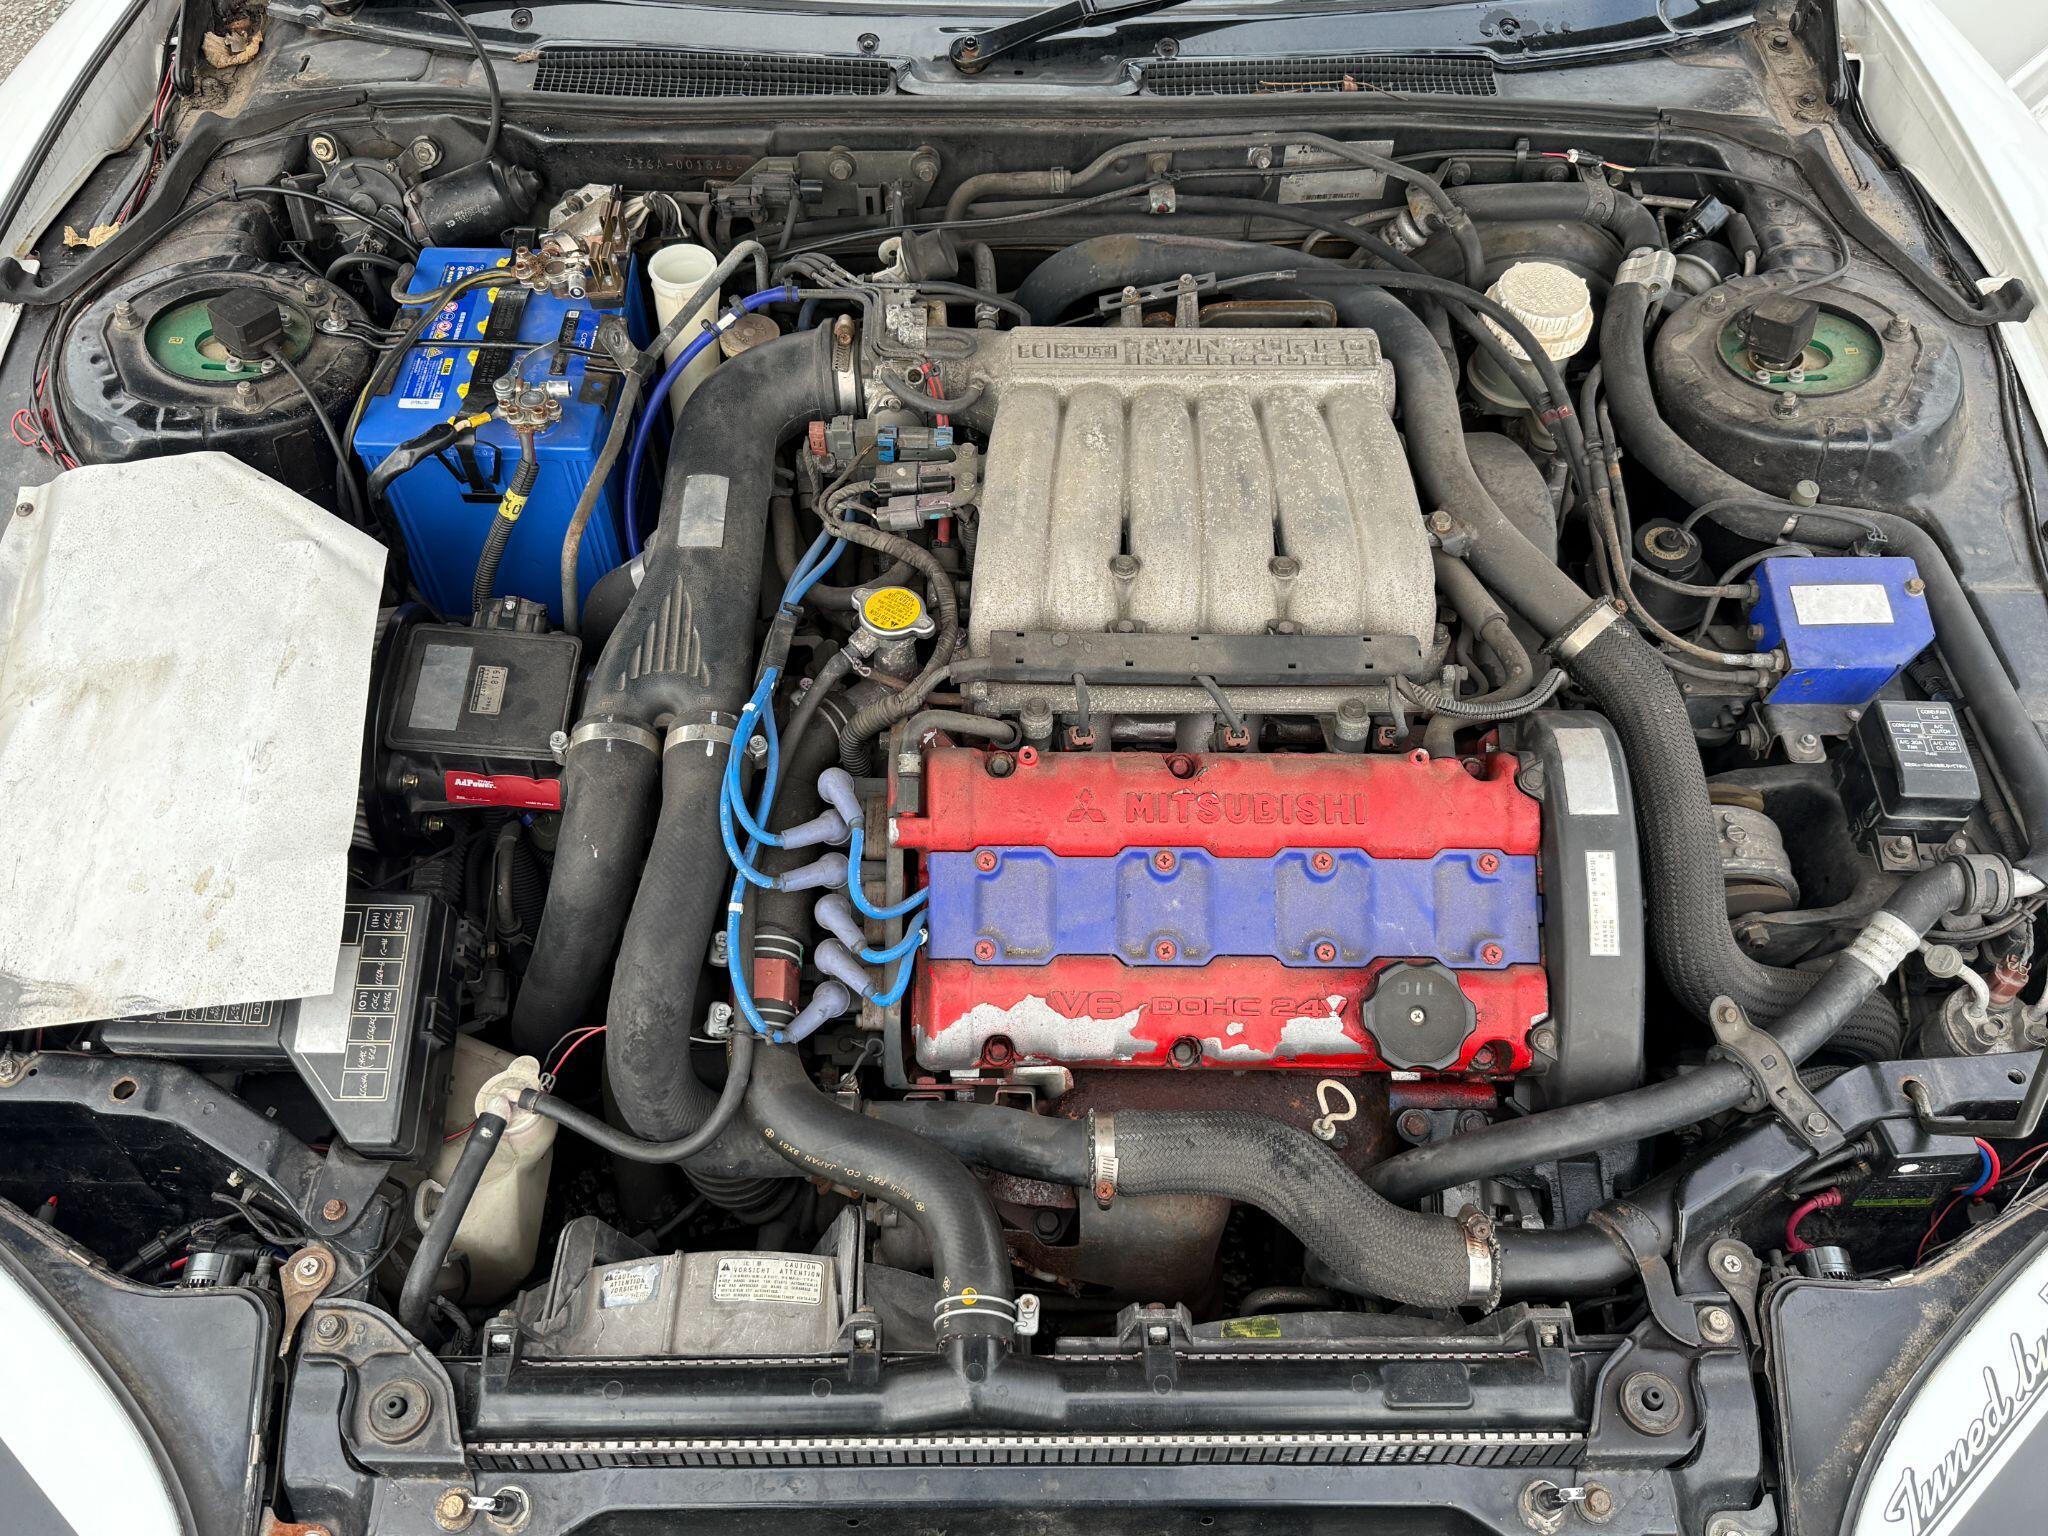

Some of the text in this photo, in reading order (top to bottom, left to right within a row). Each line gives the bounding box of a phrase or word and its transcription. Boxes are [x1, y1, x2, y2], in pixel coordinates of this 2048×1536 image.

[1055, 343, 1118, 359] MULTI
[1124, 791, 1367, 825] MITSUBISHI
[358, 991, 369, 1011] (LO)
[1051, 990, 1348, 1019] V6 DOHC 24V
[804, 1154, 837, 1171] JAPAN
[843, 1167, 861, 1178] CO.
[866, 1174, 887, 1187] R&C
[779, 1268, 820, 1278] ATTENTION
[785, 1261, 816, 1270] CAUTION
[1884, 1366, 2015, 1536] Tuned
